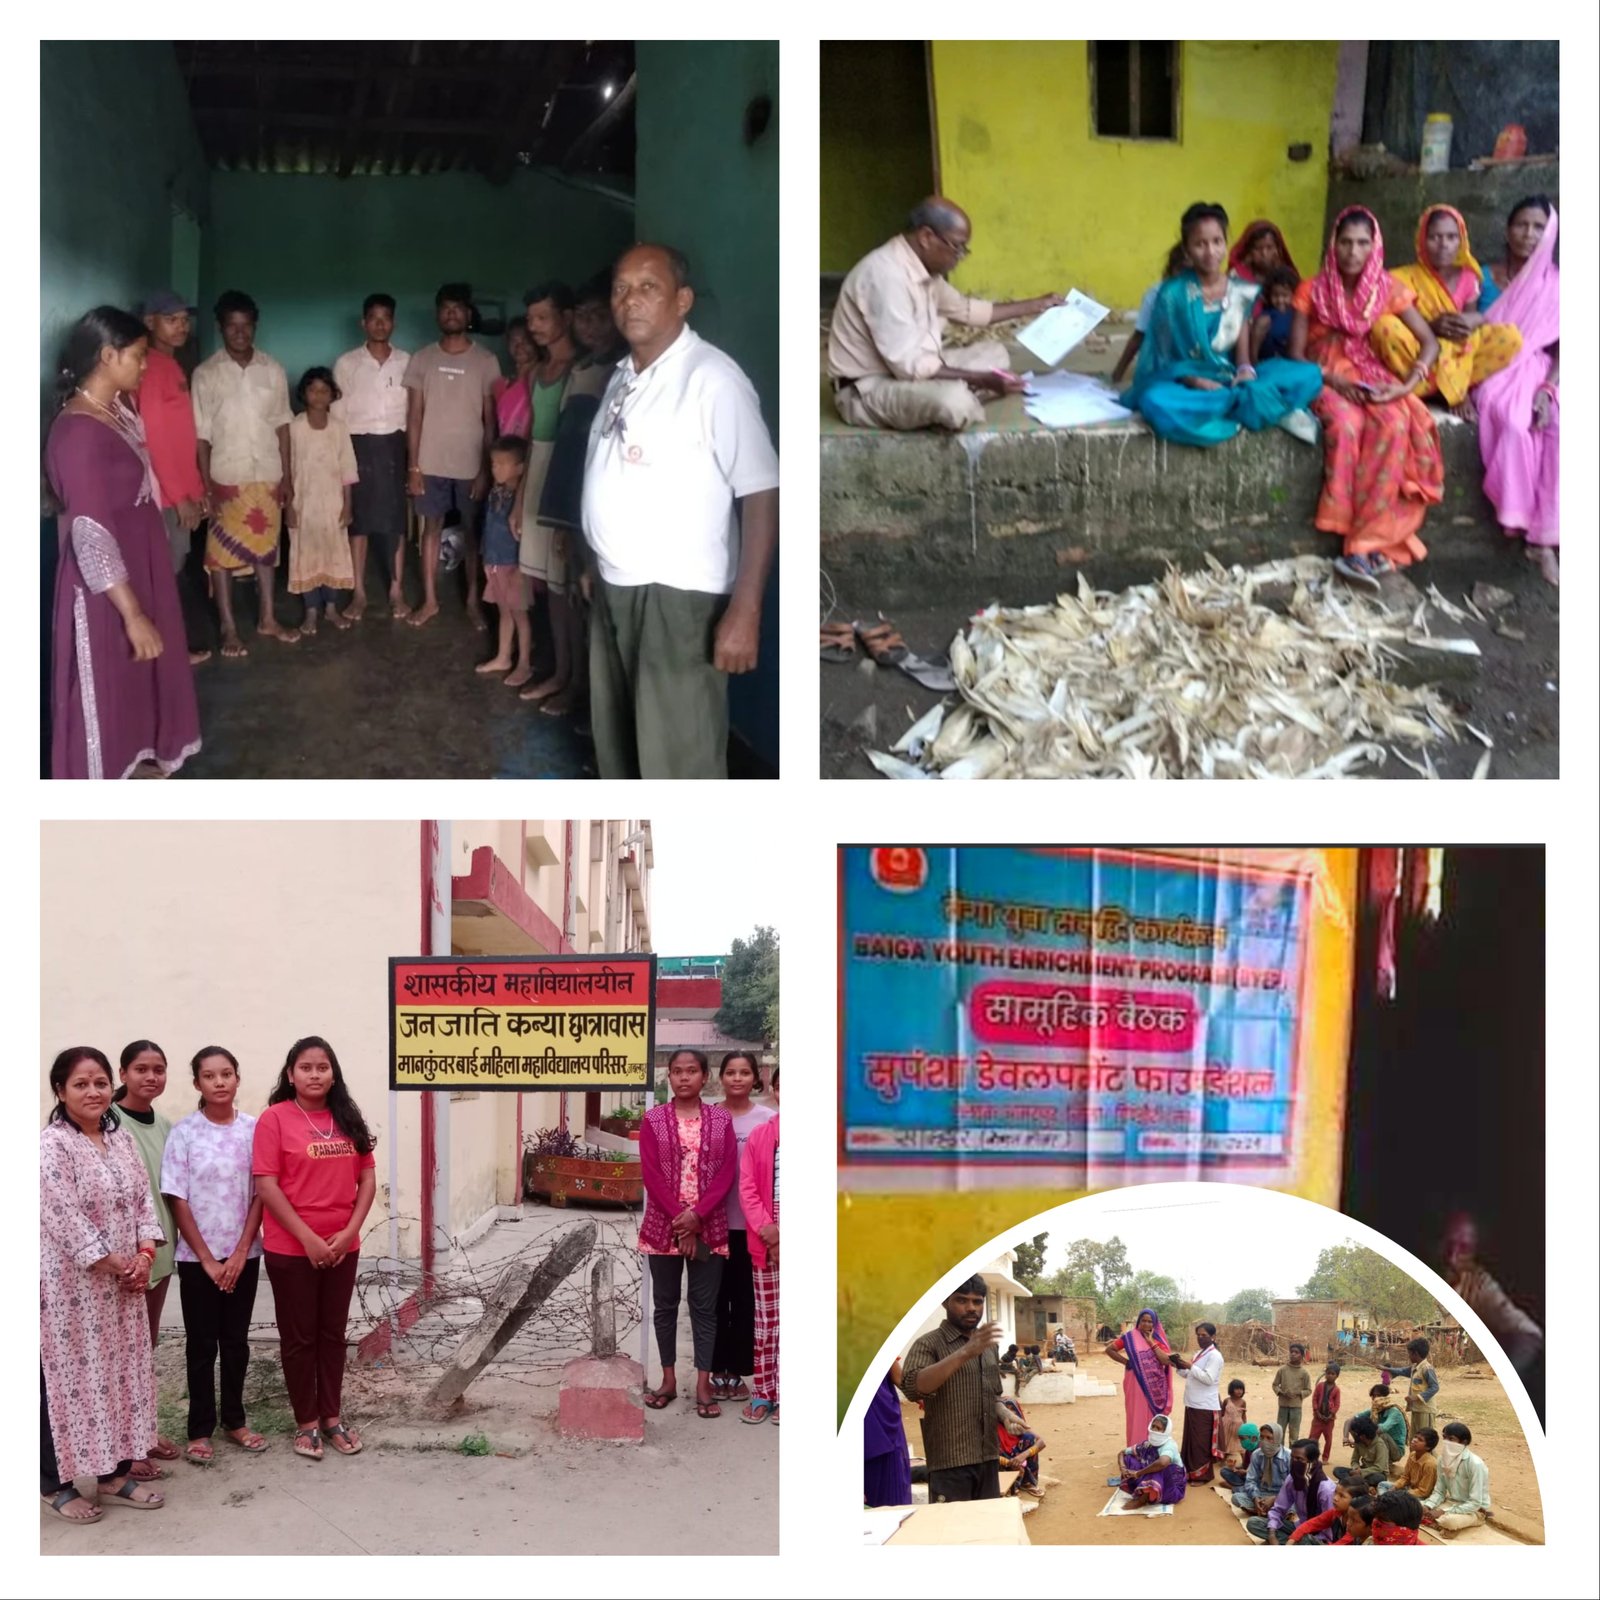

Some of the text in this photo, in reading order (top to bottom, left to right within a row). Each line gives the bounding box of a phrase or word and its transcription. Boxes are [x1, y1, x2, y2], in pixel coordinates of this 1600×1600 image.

[854, 937, 926, 961] BAIGA
[932, 943, 1007, 967] YOUTH
[1009, 946, 1136, 978] ENRICHMENT
[404, 966, 635, 1000] शासकीय महाविद्यालयीन
[400, 1007, 646, 1043] जनजाति कन्या छात्रावास
[985, 991, 1188, 1036] सामूहिक बैठक
[456, 1047, 479, 1077] बाई
[479, 1046, 521, 1078] महिला
[522, 1046, 591, 1078] महाविद्यालय
[312, 1142, 353, 1156] PARADISE
